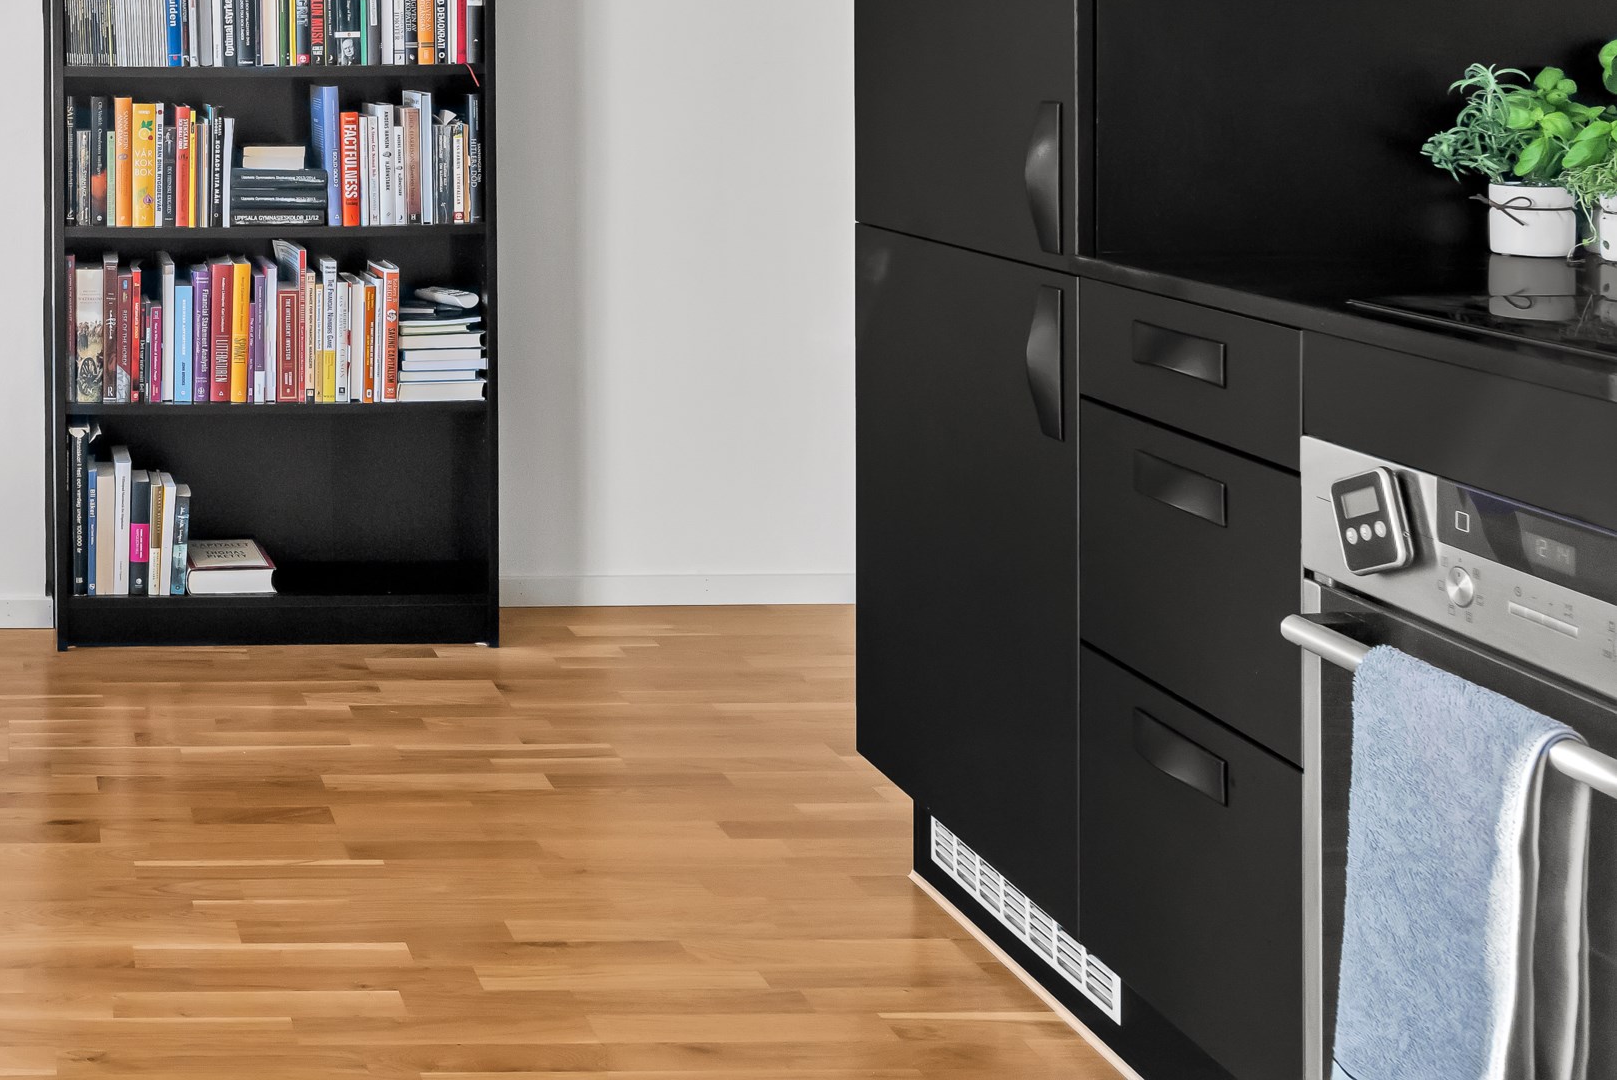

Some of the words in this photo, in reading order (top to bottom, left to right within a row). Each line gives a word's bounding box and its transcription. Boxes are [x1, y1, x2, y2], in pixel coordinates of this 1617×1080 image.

[311, 17, 324, 45] MUSK
[411, 22, 417, 32] AV
[436, 7, 445, 49] DEMOKRATI
[223, 25, 234, 57] Optimal
[134, 148, 153, 157] VÅR
[134, 159, 153, 167] KOK
[344, 124, 358, 199] FACTFULNESS
[134, 168, 153, 177] BOK
[201, 289, 209, 316] Financial
[122, 323, 127, 332] OF
[201, 317, 209, 347] Statement
[387, 327, 396, 349] SAVING
[201, 348, 209, 373] Analysis
[215, 339, 229, 383] LITTERATUREN
[387, 349, 396, 384] CAPITALISM
[107, 386, 114, 397] R
